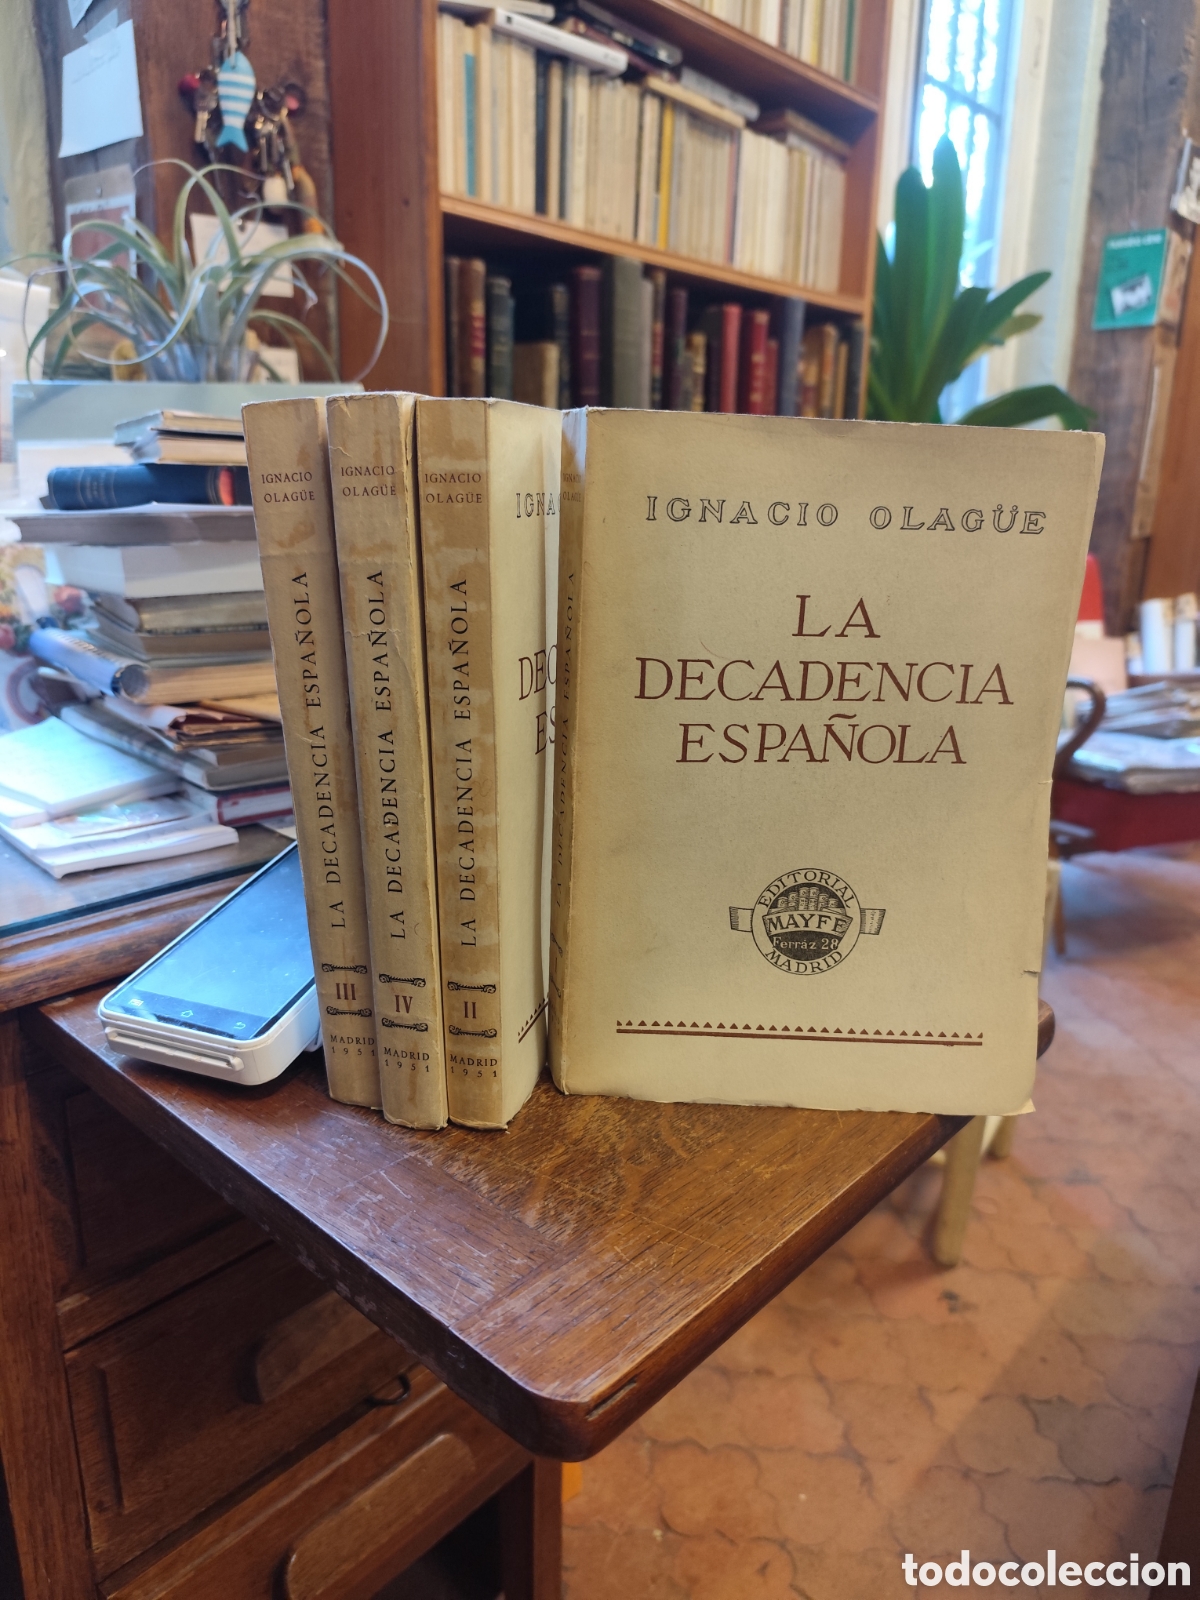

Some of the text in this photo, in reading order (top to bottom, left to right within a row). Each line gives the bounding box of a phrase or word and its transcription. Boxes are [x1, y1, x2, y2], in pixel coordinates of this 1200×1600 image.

[262, 471, 313, 484] IGNACIO
[340, 465, 395, 477] IGNACIO
[424, 473, 482, 484] IGNACIO
[263, 490, 315, 503] OLAGÜE
[342, 484, 397, 497] OLAGÜE
[425, 492, 483, 504] OLAGÜE
[516, 493, 561, 518] IGNA
[646, 496, 1047, 535] IGNACIO OLAGÜE
[792, 595, 880, 638] LA
[634, 657, 1014, 705] DECADENCIA
[676, 713, 967, 765] ESPAÑOLA
[291, 572, 346, 928] LA DECADENCIA ESPAÑOLA
[366, 570, 406, 939] LA DECADENCIA ESPAÑOLA
[449, 579, 477, 947] LA DECADENCIA ESPAÑOLA
[758, 871, 855, 908] EDITORIAL
[767, 913, 848, 934] MAYFE
[821, 938, 838, 950] 28
[765, 948, 843, 973] MADRID
[335, 983, 356, 1000] III
[395, 995, 413, 1014] IV
[464, 1001, 477, 1018] II
[331, 1035, 375, 1046] MADRID
[384, 1047, 429, 1061] MADRID
[450, 1054, 497, 1067] MADRID
